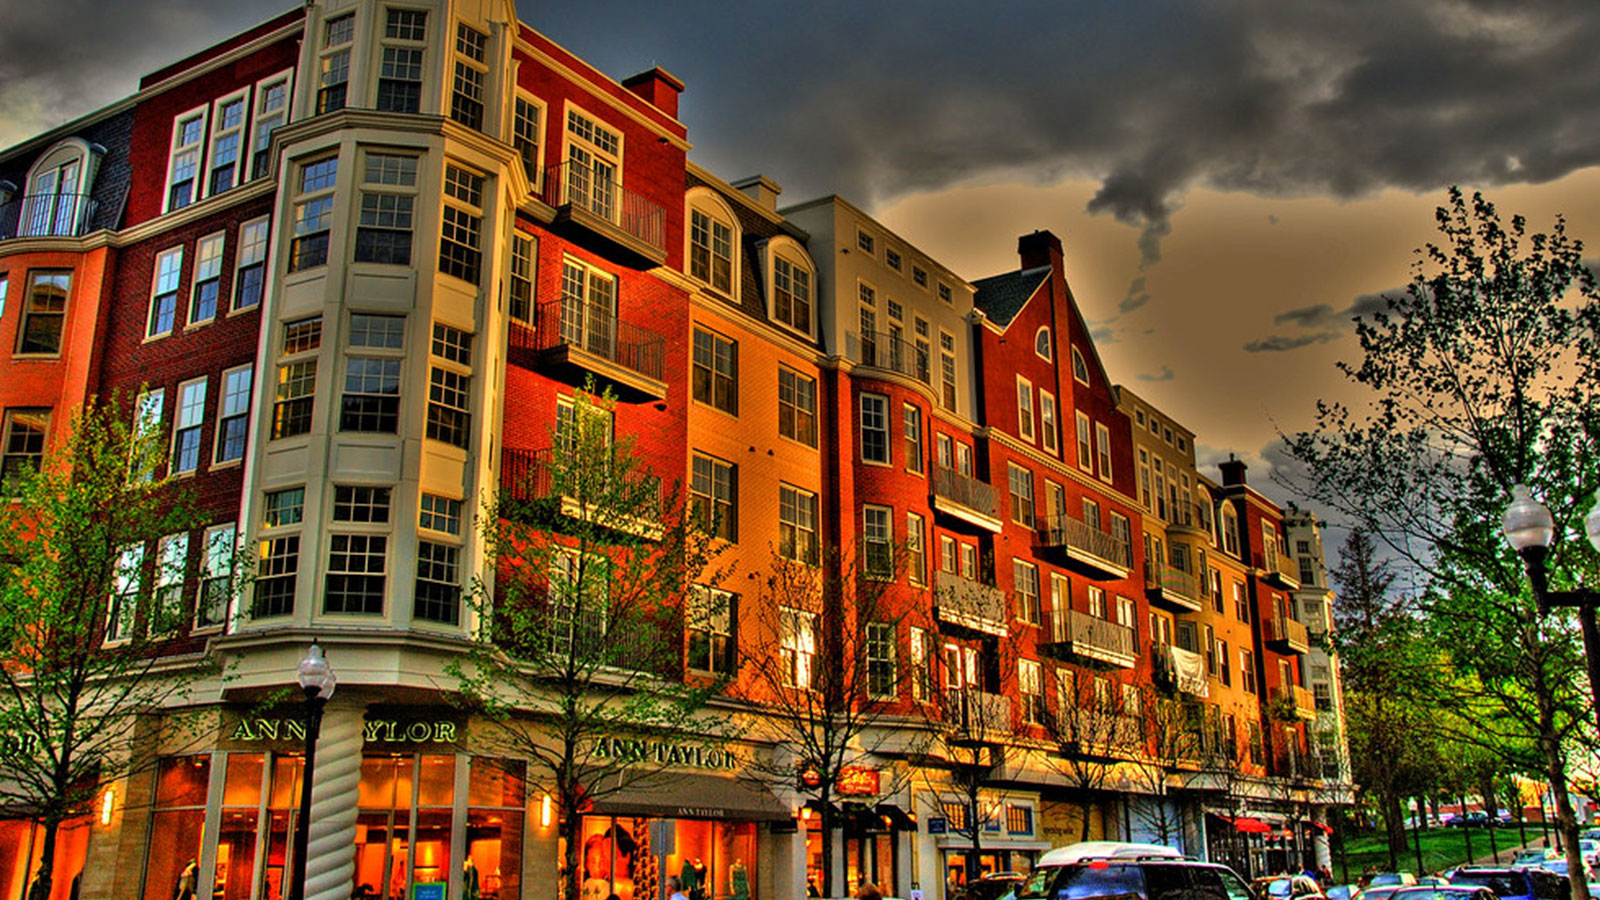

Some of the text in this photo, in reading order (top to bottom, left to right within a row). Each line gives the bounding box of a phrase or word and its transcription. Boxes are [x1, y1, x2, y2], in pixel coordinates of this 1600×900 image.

[230, 718, 457, 743] ANN YLOR
[592, 737, 735, 769] ANN TAYLOR
